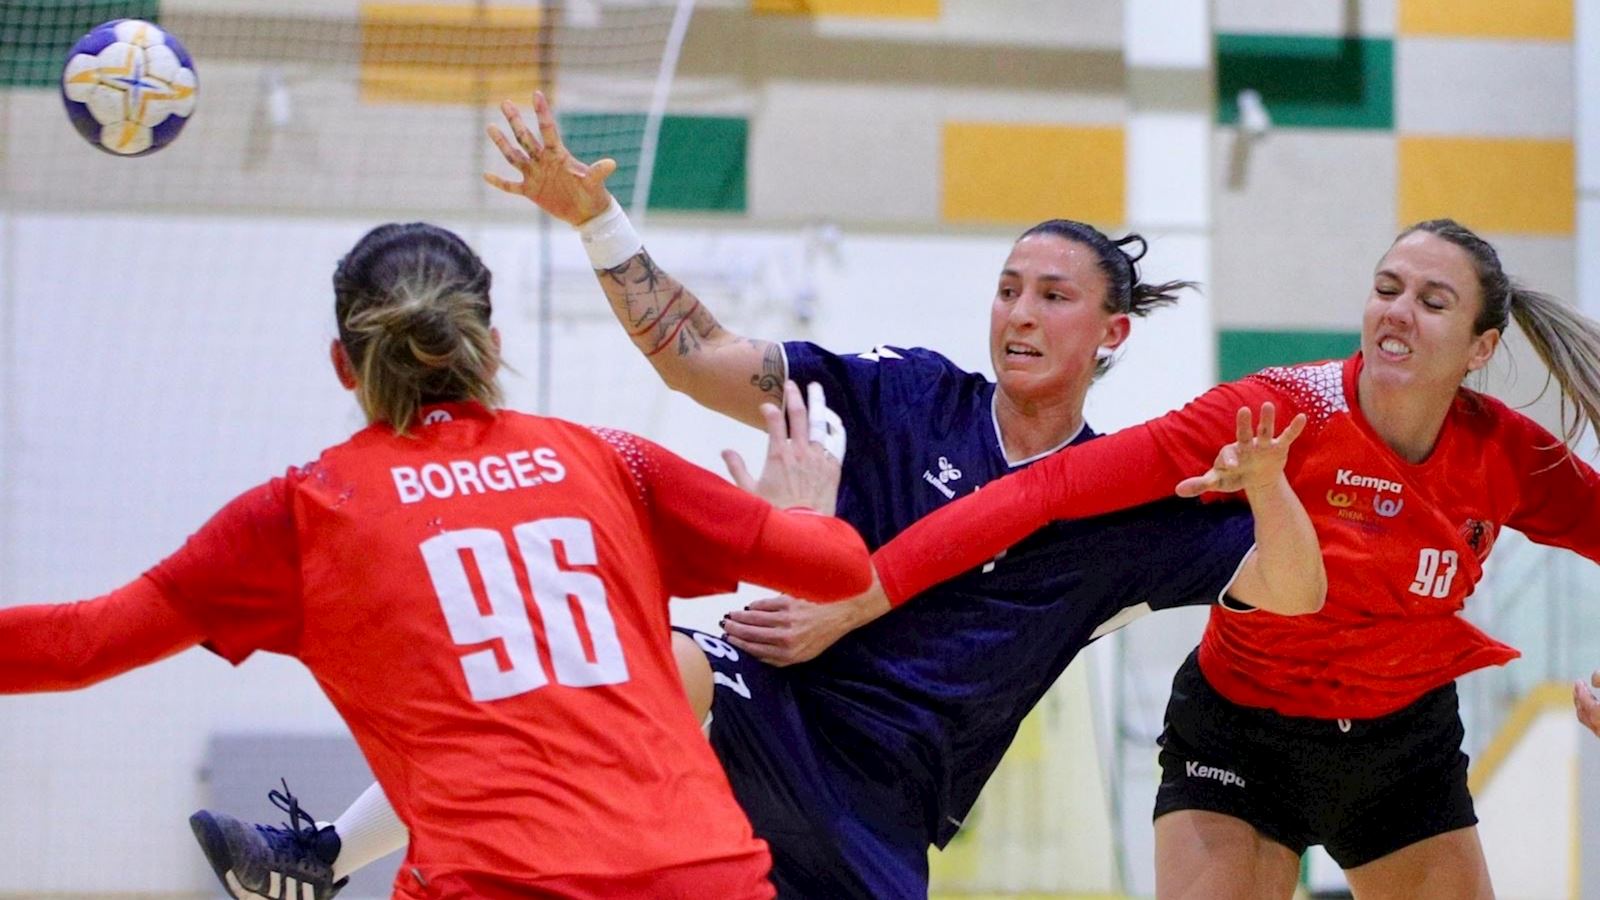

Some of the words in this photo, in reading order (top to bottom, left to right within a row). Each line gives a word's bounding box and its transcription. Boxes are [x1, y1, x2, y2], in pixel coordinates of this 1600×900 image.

[391, 447, 567, 504] BORGES
[1335, 468, 1403, 494] Kempa
[1407, 547, 1459, 599] 93
[418, 516, 630, 702] 96
[1185, 760, 1247, 789] Kempa
